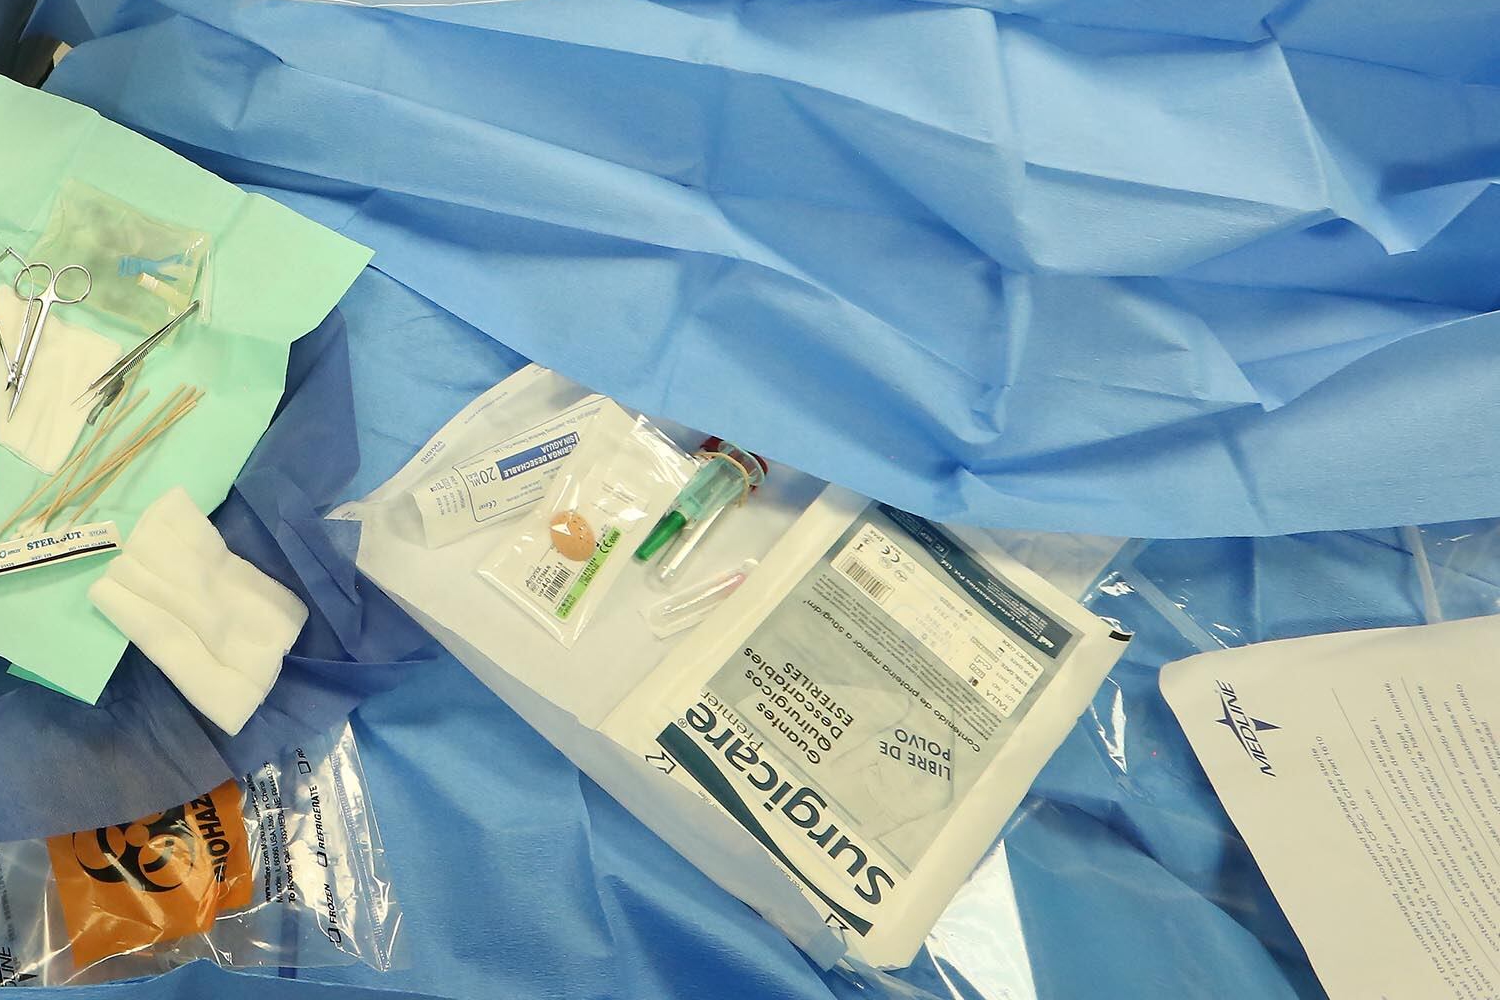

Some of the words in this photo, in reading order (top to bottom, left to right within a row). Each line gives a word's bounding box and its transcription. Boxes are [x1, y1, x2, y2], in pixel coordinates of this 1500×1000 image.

[540, 439, 565, 453] AGUJA
[479, 466, 497, 484] 20
[503, 455, 549, 477] DESECHABLE
[966, 579, 996, 605] Industries
[852, 640, 881, 664] menor
[744, 648, 842, 739] Descartables
[783, 662, 853, 726] ESTERILES
[919, 697, 932, 709] de
[986, 689, 1008, 711] TALLA
[699, 692, 764, 751] Premier
[745, 670, 831, 751] Quirurgicos
[756, 702, 820, 764] Guantes
[933, 710, 980, 752] Contenido
[1216, 679, 1276, 777] MEDLINE
[1374, 724, 1391, 752] classe
[1403, 723, 1418, 748] haute
[879, 741, 901, 760] DE
[895, 729, 951, 761] POLVO
[1315, 736, 1329, 756] 1610
[1439, 735, 1459, 768] cuando
[908, 751, 951, 781] LIBRE
[1423, 766, 1445, 799] chaleur
[686, 702, 896, 906] Surgicare
[1397, 769, 1421, 807] normale
[1461, 778, 1486, 818] siempre
[310, 785, 326, 849] REFRIGERATE
[1336, 796, 1362, 834] package
[1356, 813, 1377, 841] CPSC
[1453, 816, 1474, 848] source
[1359, 837, 1392, 886] unopened
[1381, 855, 1407, 892] defined
[1395, 856, 1414, 885] flame
[1400, 847, 1426, 889] intensity
[1436, 858, 1462, 892] paquet
[328, 883, 338, 923] FROZEN
[1392, 890, 1431, 953] undamaged,
[1425, 907, 1457, 954] exposed
[1451, 932, 1472, 962] flame
